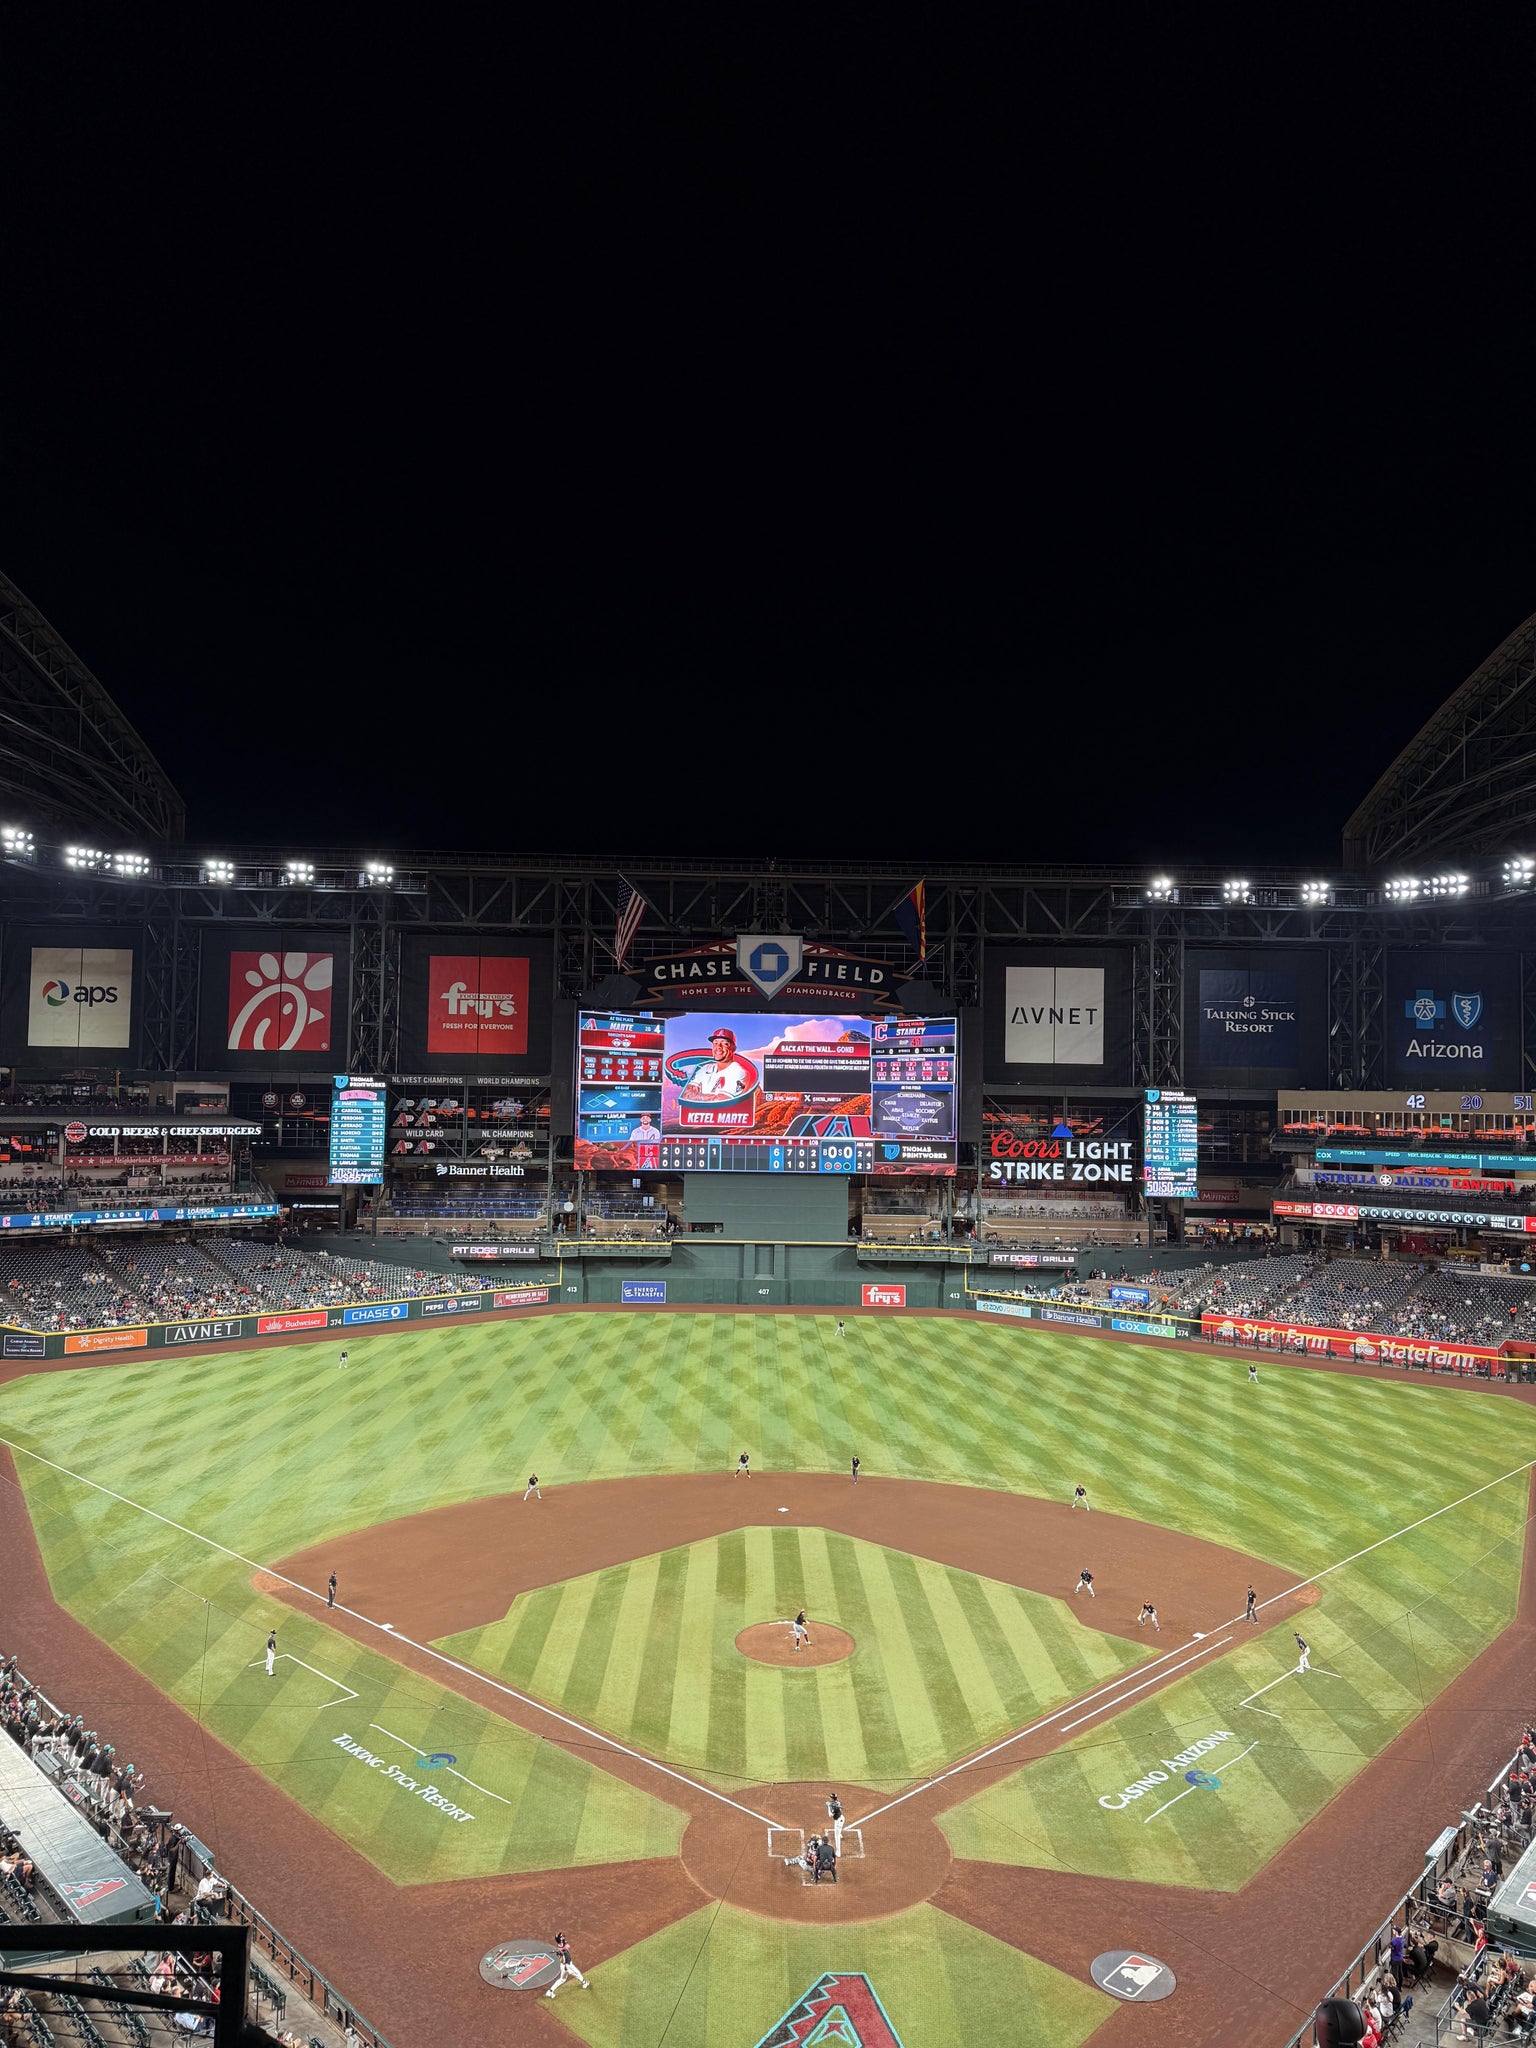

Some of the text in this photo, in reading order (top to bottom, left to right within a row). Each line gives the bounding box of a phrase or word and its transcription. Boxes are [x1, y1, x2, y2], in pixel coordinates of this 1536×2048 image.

[653, 961, 884, 984] CHASE FIELD
[73, 982, 118, 1007] aps
[681, 987, 708, 996] HOME
[715, 986, 727, 994] OF
[786, 987, 857, 999] DIAMONDBACKS
[440, 982, 517, 1019] fry's
[1011, 1007, 1098, 1025] AVNET
[1203, 1008, 1296, 1021] TALKING STICK
[480, 1023, 514, 1031] EVERYONE
[609, 1022, 660, 1034] MARTE 4
[896, 1027, 927, 1036] STANLEY
[1225, 1021, 1274, 1033] RESORT
[781, 1045, 797, 1053] BACK
[940, 1046, 945, 1054] 0
[1405, 1039, 1484, 1059] Arizona
[477, 1077, 500, 1085] WORLD
[1406, 1094, 1425, 1109] 42
[1460, 1095, 1483, 1110] 20
[1513, 1095, 1533, 1111] 51
[687, 1112, 749, 1124] KETEL MARTE
[89, 1127, 120, 1136] COLD
[122, 1127, 159, 1136] BEERS
[169, 1126, 262, 1136] CHEESEBURGERS
[492, 1130, 534, 1138] CHAMPIONS
[990, 1131, 1133, 1160] Coors LIGHT
[662, 1147, 668, 1155] 2
[674, 1147, 680, 1155] 0
[687, 1147, 693, 1155] 3
[699, 1147, 705, 1155] 0
[773, 1148, 780, 1156] 6
[811, 1149, 817, 1157] 2
[828, 1146, 838, 1159] 0
[843, 1146, 853, 1159] 0
[100, 1155, 187, 1165] Your Neighborhood Burger Joint
[699, 1160, 705, 1168] 0
[773, 1160, 780, 1168] 0
[449, 1165, 525, 1176] Banner Health
[990, 1161, 1133, 1182] STRIKE ZONE
[295, 1178, 323, 1186] FITNESS
[1313, 1172, 1516, 1192] ESTRELLA JALISCO CANTINA
[1511, 1219, 1518, 1227] 4
[452, 1246, 469, 1254] PIT
[469, 1246, 499, 1254] BOSS
[993, 1254, 1075, 1263] PIT BOSS GRILLS
[867, 1286, 901, 1305] fry's
[425, 1299, 479, 1312] PEPSI PEPSI
[351, 1308, 389, 1321] CHASE
[1052, 1312, 1097, 1326] Banner Health
[285, 1318, 321, 1329] Budweiser
[329, 1318, 342, 1327] 374
[1119, 1321, 1168, 1336] COX COX
[173, 1322, 234, 1341] AVNET
[1176, 1329, 1189, 1337] 374
[93, 1337, 113, 1345] Dignity
[1098, 1729, 1236, 1810] CASINO ARIZONA
[331, 1732, 476, 1823] TALKING STICK RESORT
